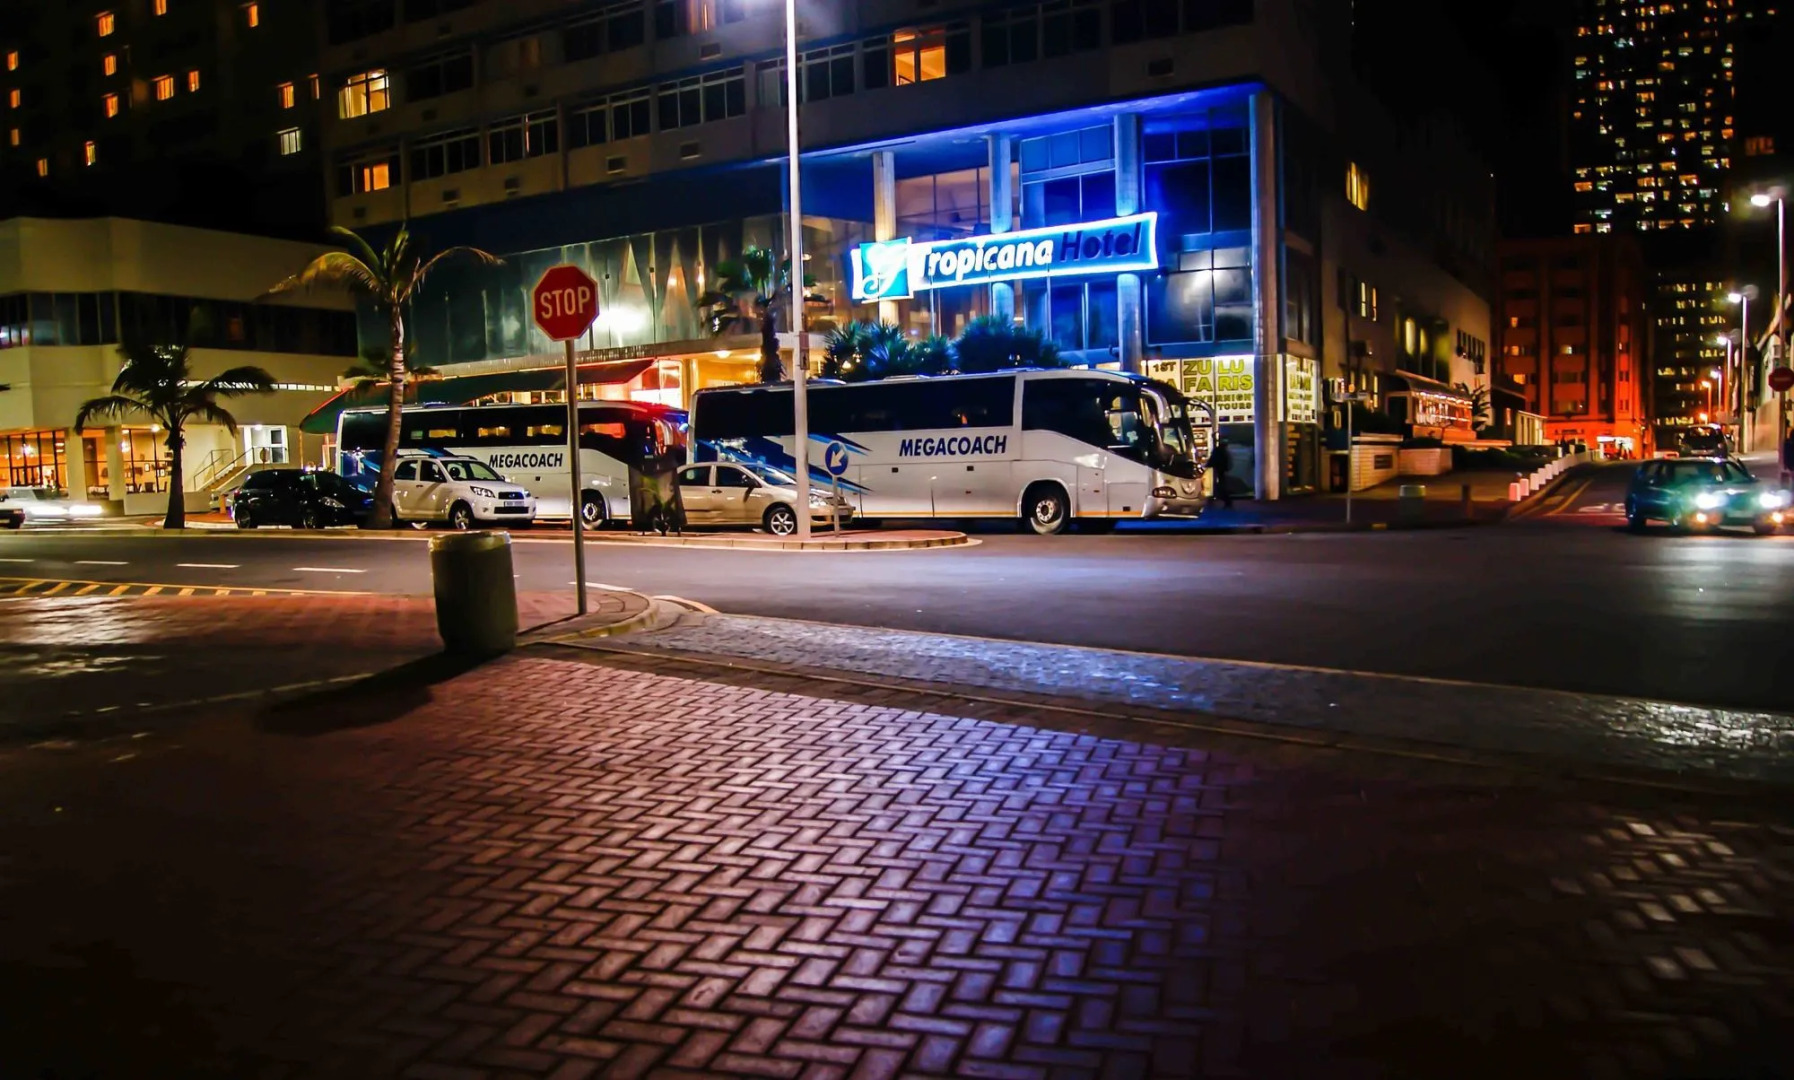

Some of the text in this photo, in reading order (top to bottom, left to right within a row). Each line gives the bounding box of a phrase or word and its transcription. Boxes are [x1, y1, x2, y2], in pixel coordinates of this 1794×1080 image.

[918, 222, 1142, 282] Tropicana Hotel
[540, 286, 591, 319] STOP
[899, 435, 1008, 457] MEGACOACH
[488, 453, 563, 468] MEGACOACH
